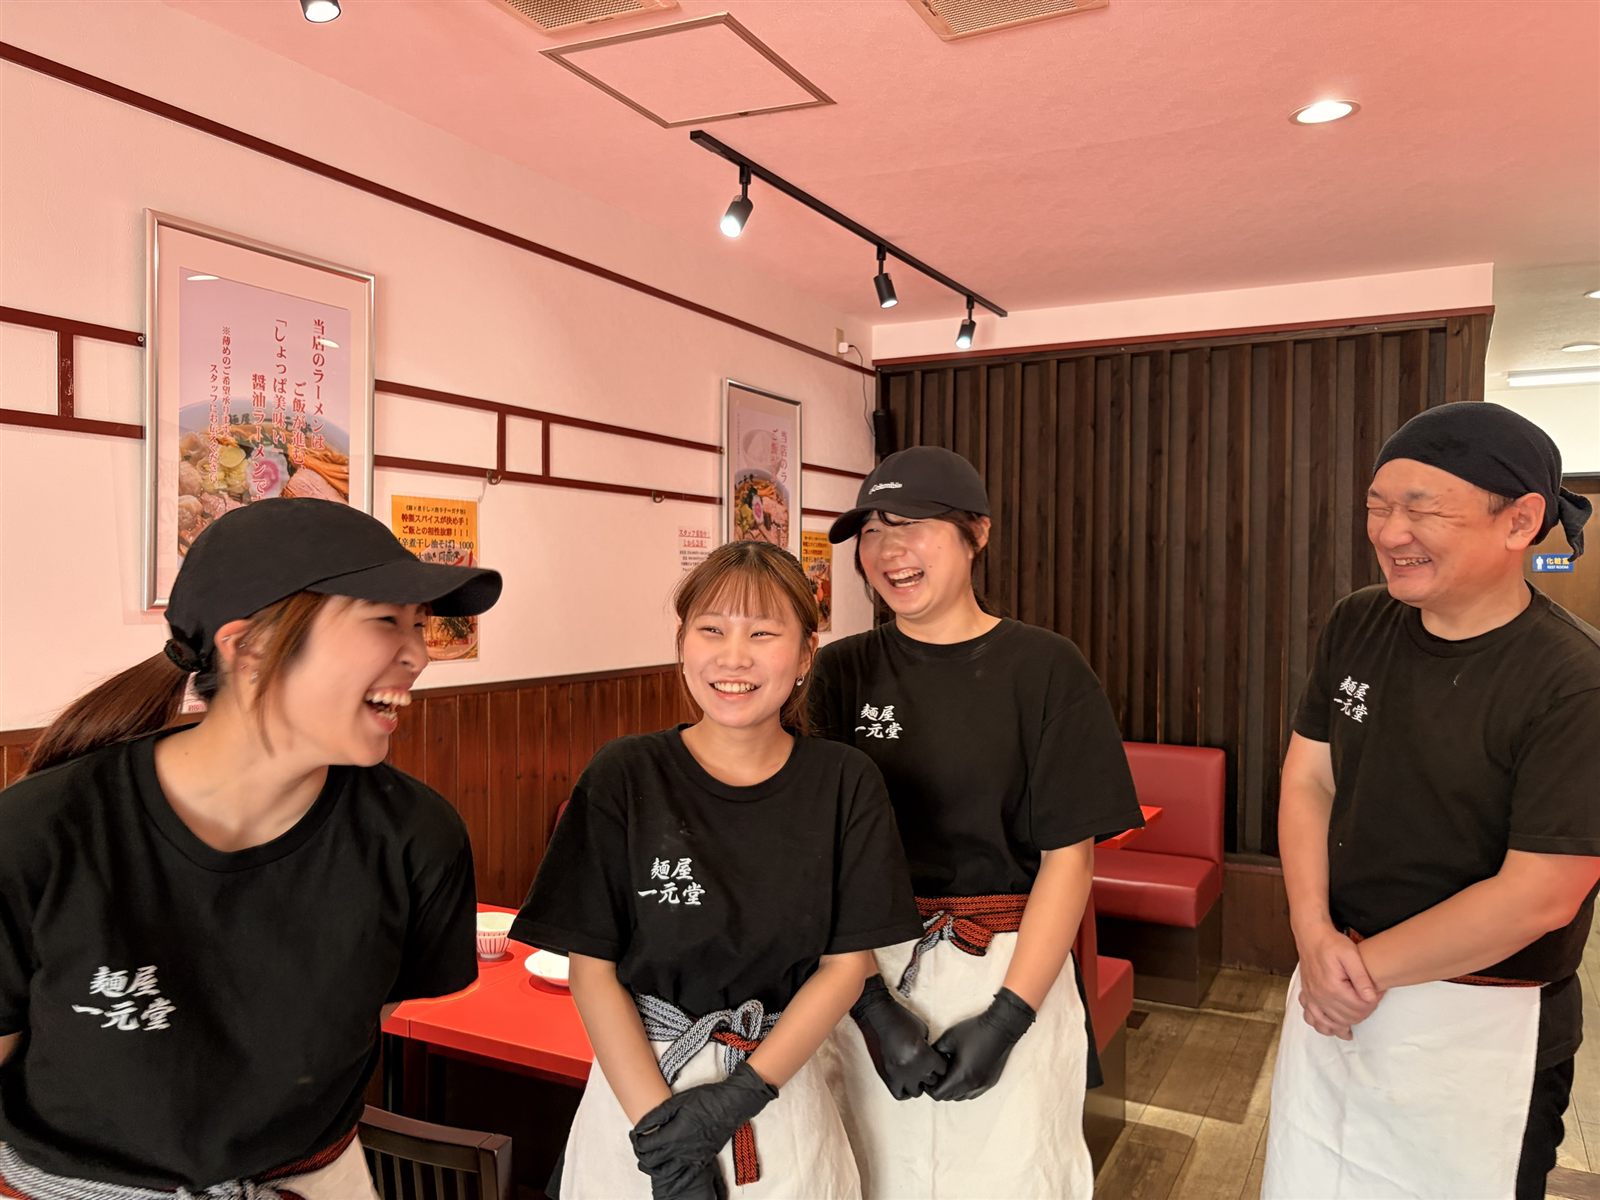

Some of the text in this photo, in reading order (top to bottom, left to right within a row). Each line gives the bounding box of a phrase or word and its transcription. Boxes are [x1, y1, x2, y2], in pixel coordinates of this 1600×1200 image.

[312, 318, 326, 450] 当店のラーメンは
[252, 373, 266, 500] 醤油ラーメンで
[1339, 675, 1370, 702] 麺屋
[860, 703, 895, 721] 麺屋
[1333, 698, 1368, 723] 一元堂
[854, 722, 903, 739] 一元堂
[650, 857, 694, 880] 麺屋
[637, 881, 706, 905] 一元堂
[89, 965, 161, 998] 麺屋
[71, 997, 177, 1031] 一元堂
